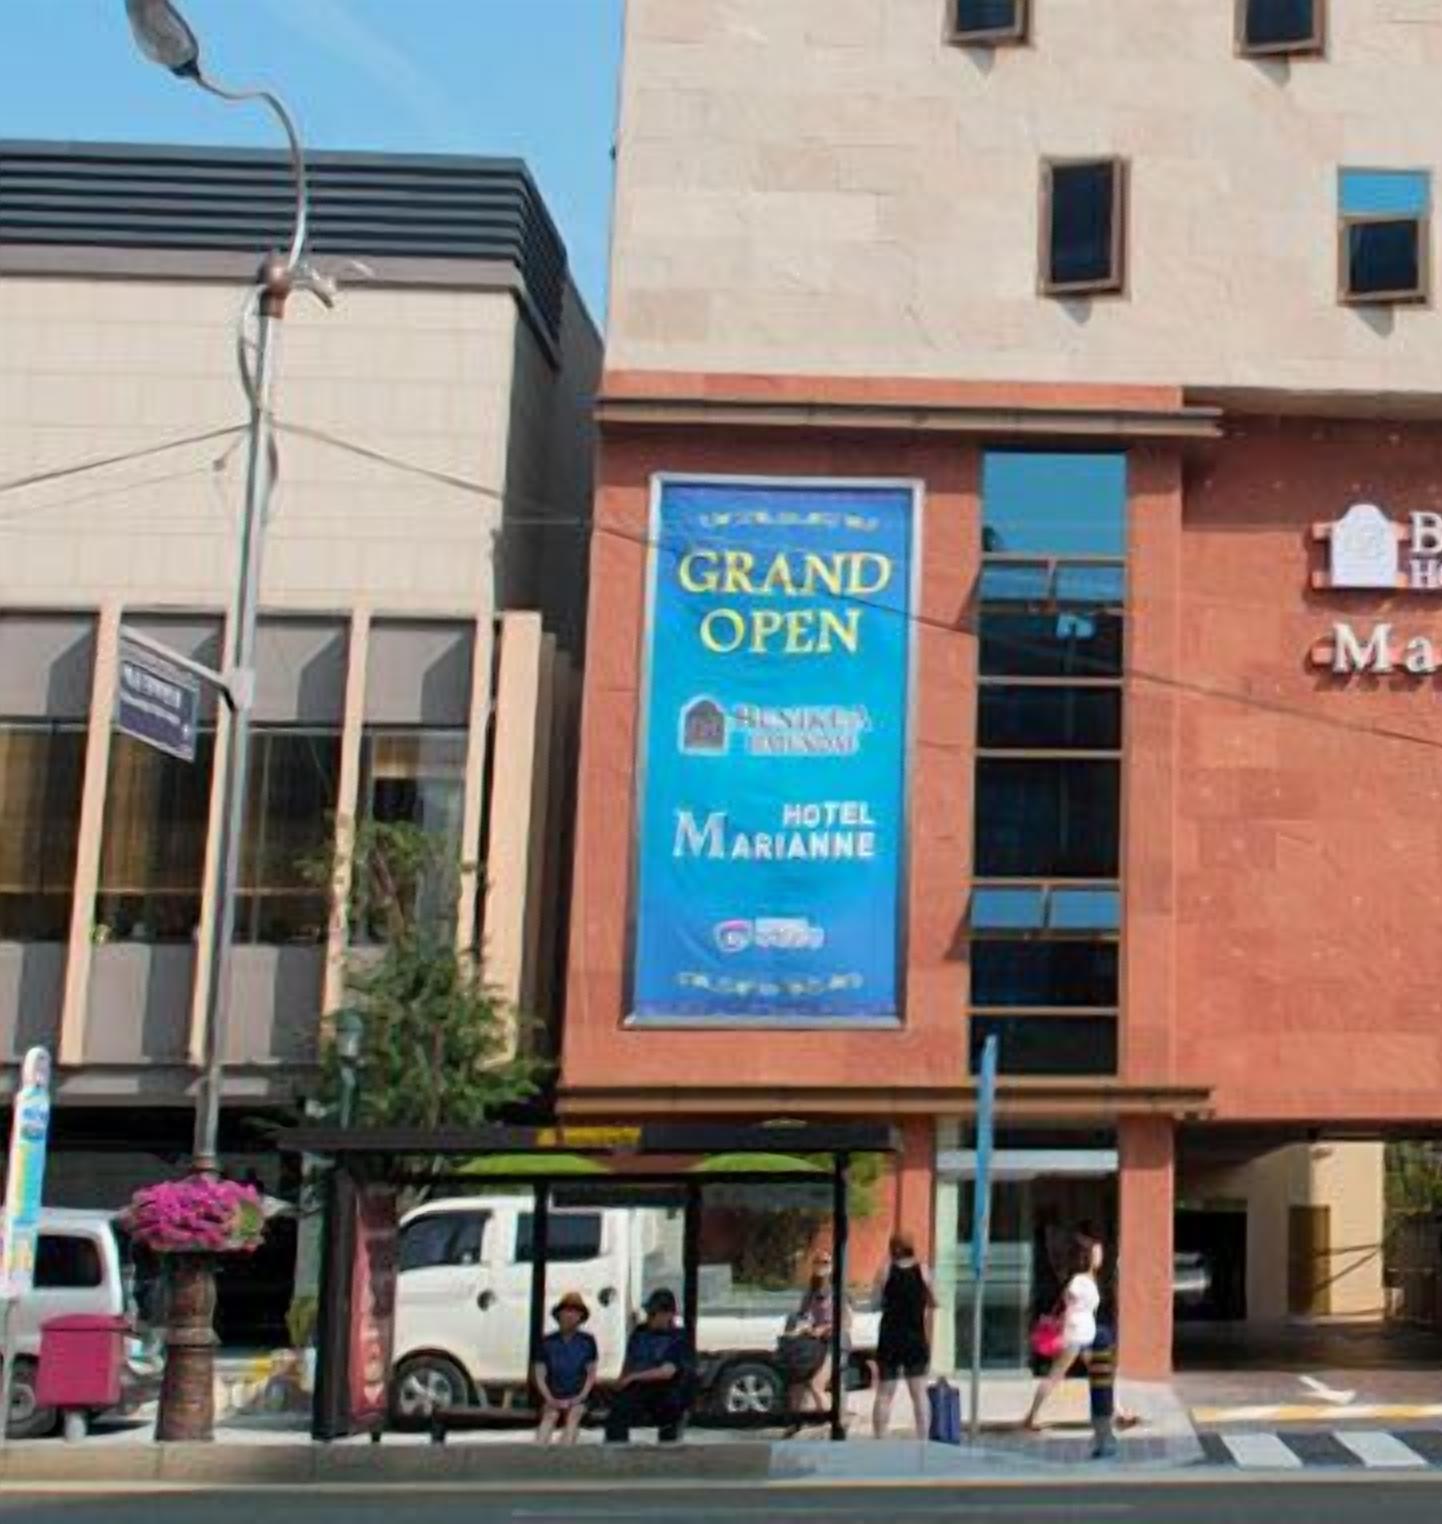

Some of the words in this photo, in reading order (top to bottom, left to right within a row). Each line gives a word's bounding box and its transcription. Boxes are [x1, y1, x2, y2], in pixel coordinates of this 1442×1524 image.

[679, 552, 891, 596] GRAND
[701, 609, 862, 653] OPEN
[673, 811, 875, 859] MARIANNE
[783, 803, 874, 826] HOTEL
